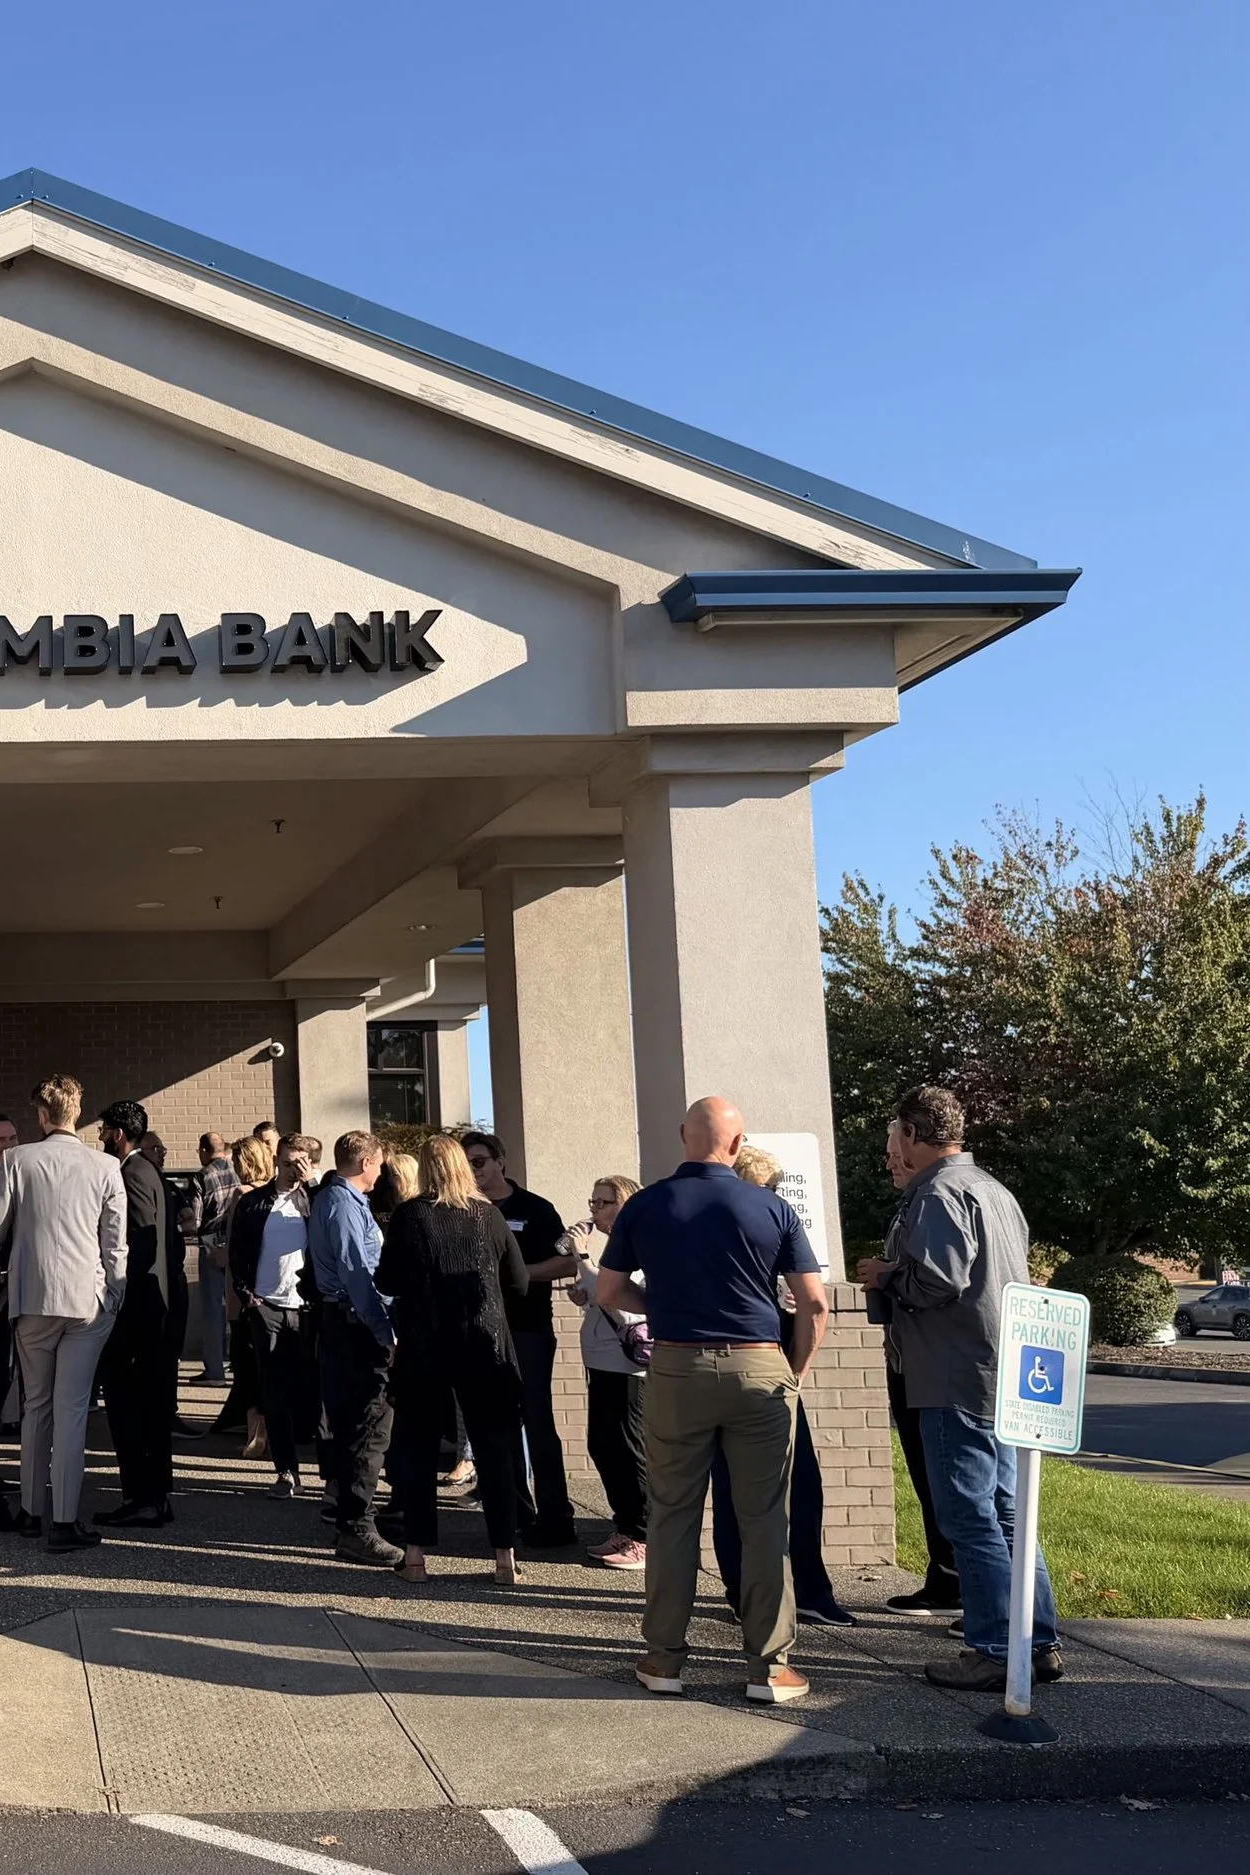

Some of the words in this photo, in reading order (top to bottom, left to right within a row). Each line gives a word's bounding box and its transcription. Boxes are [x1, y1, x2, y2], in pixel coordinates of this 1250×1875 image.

[218, 609, 445, 674] BANK
[1010, 1296, 1082, 1326] RESERVED
[1011, 1322, 1077, 1351] PARKING
[1005, 1400, 1021, 1410] STATE
[1004, 1420, 1020, 1431] VAN
[1024, 1422, 1073, 1441] ACCESSIBLE
